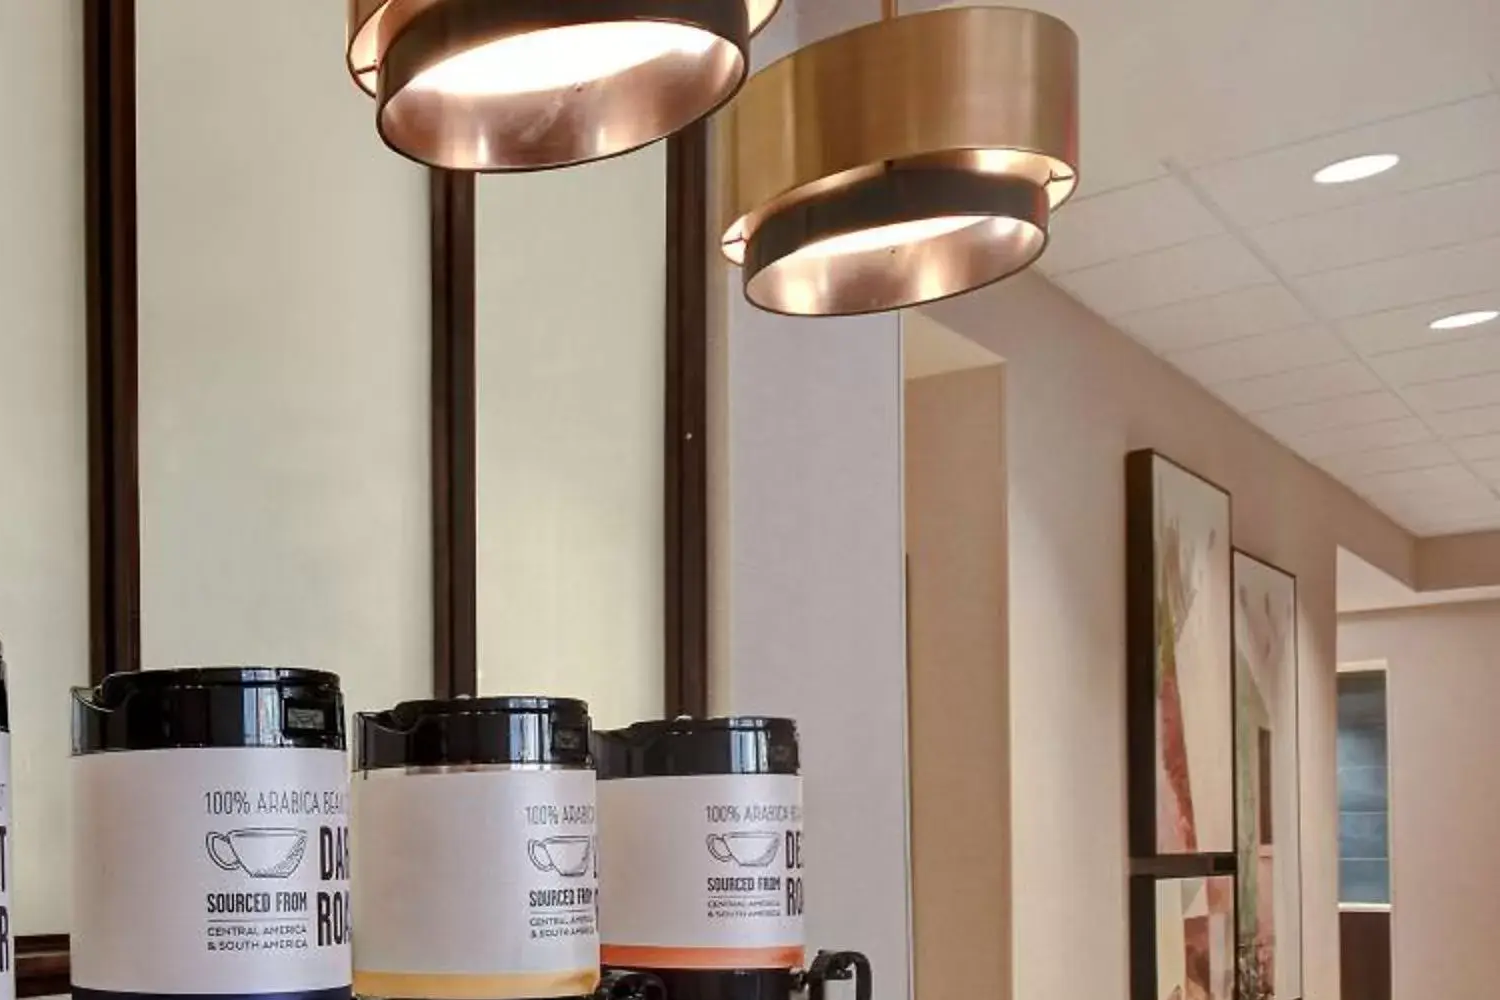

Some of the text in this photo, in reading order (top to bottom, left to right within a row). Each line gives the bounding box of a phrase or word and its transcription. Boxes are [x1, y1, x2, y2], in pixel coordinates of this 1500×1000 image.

[205, 791, 250, 815] 100%
[257, 791, 320, 814] ARABICA
[525, 805, 559, 825] 100%
[706, 805, 740, 822] 100%
[707, 877, 780, 891] SOURCED FROM
[207, 891, 308, 913] SOURCED FROM
[529, 888, 575, 907] SOURCED
[207, 925, 307, 937] CENTRAL AMERICA
[207, 939, 308, 951] & SOUTH AMERICA
